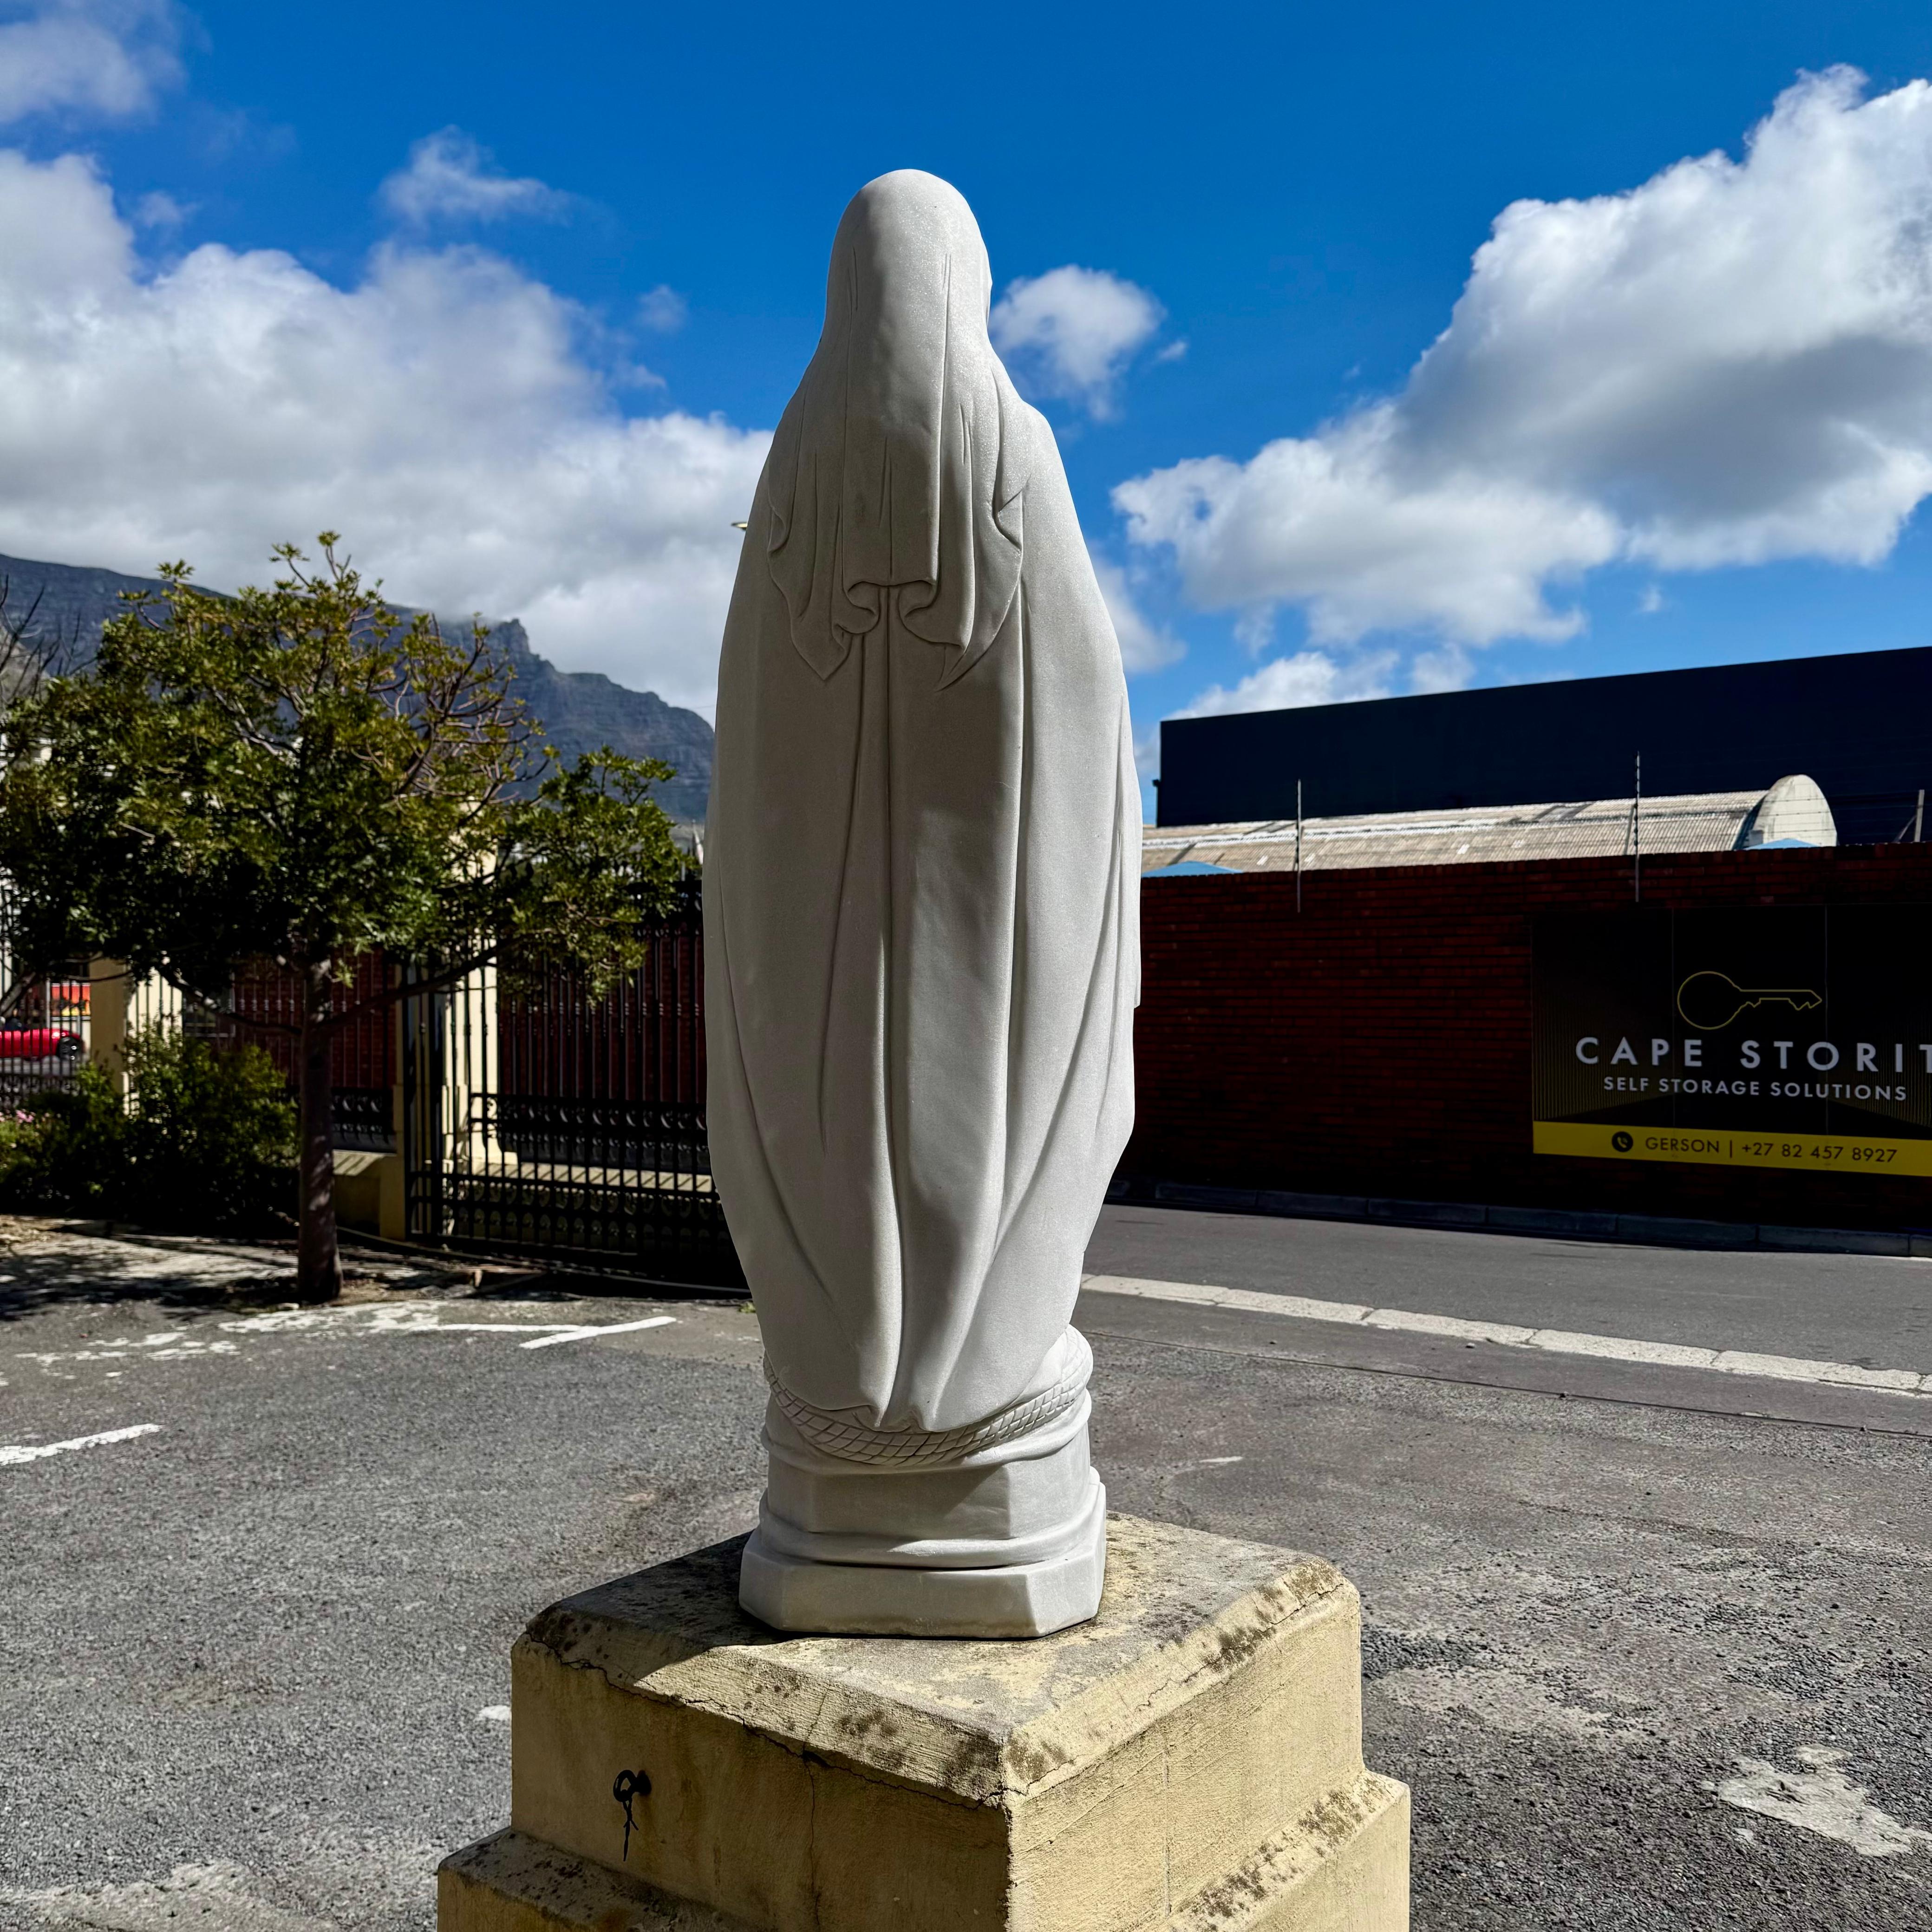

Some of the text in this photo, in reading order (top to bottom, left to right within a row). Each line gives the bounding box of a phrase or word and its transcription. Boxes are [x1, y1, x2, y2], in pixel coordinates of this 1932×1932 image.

[1575, 1037, 1932, 1073] CAPE STORIT
[1604, 1077, 1906, 1101] SELF STORAGE SOLUTIONS
[1645, 1137, 1720, 1154] GERSON
[1741, 1142, 1774, 1156] +27
[1781, 1143, 1802, 1158] 82
[1810, 1145, 1844, 1160] 457
[1851, 1147, 1898, 1163] 8927
